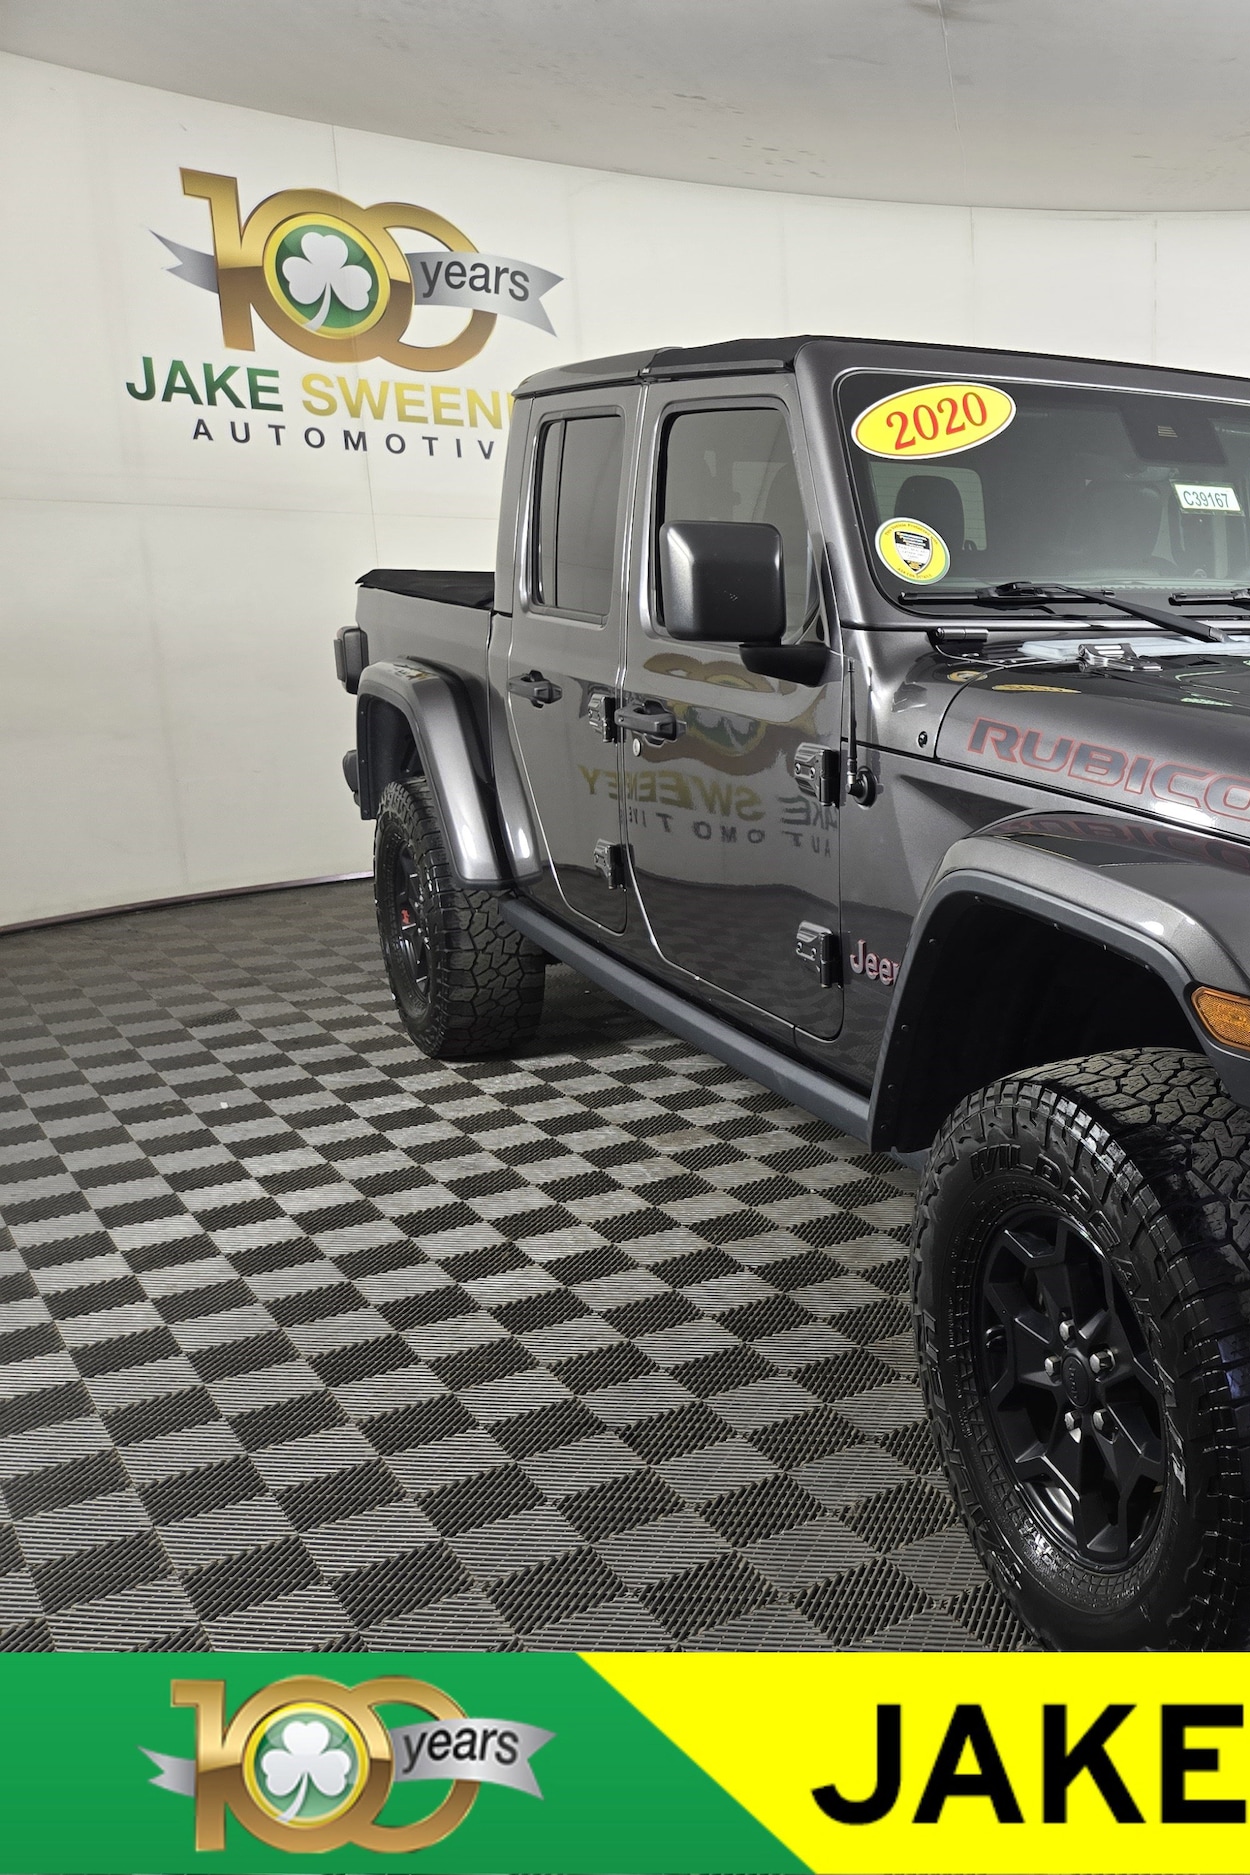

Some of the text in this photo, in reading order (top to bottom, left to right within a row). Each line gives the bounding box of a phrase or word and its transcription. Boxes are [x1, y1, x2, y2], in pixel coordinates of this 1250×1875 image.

[420, 259, 531, 302] years
[126, 356, 515, 430] JAKE SWEEN
[192, 418, 495, 461] AUTOMOTIV
[885, 391, 988, 450] 2020
[1182, 490, 1230, 508] C39167
